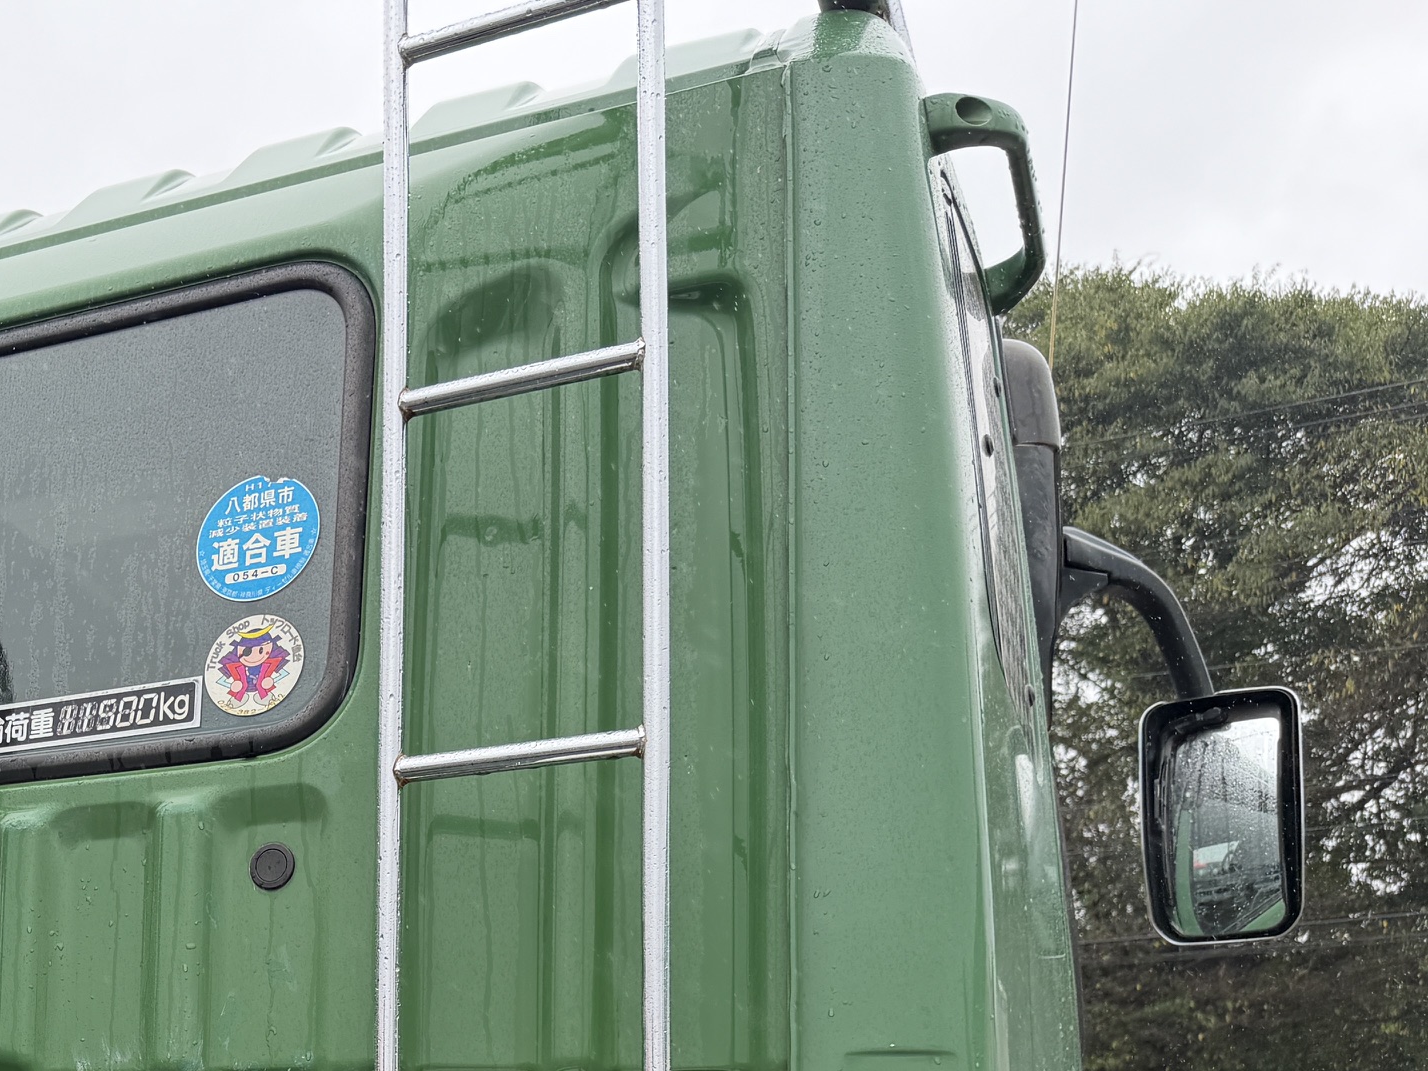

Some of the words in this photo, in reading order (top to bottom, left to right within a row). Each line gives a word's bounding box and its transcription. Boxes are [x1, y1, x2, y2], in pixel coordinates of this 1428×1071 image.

[217, 503, 300, 527] 粒子状物質
[225, 486, 295, 515] 八都県市
[209, 512, 308, 539] 減少装置装着
[211, 527, 303, 571] 適合車
[207, 641, 226, 671] Truck
[226, 620, 250, 639] Shop
